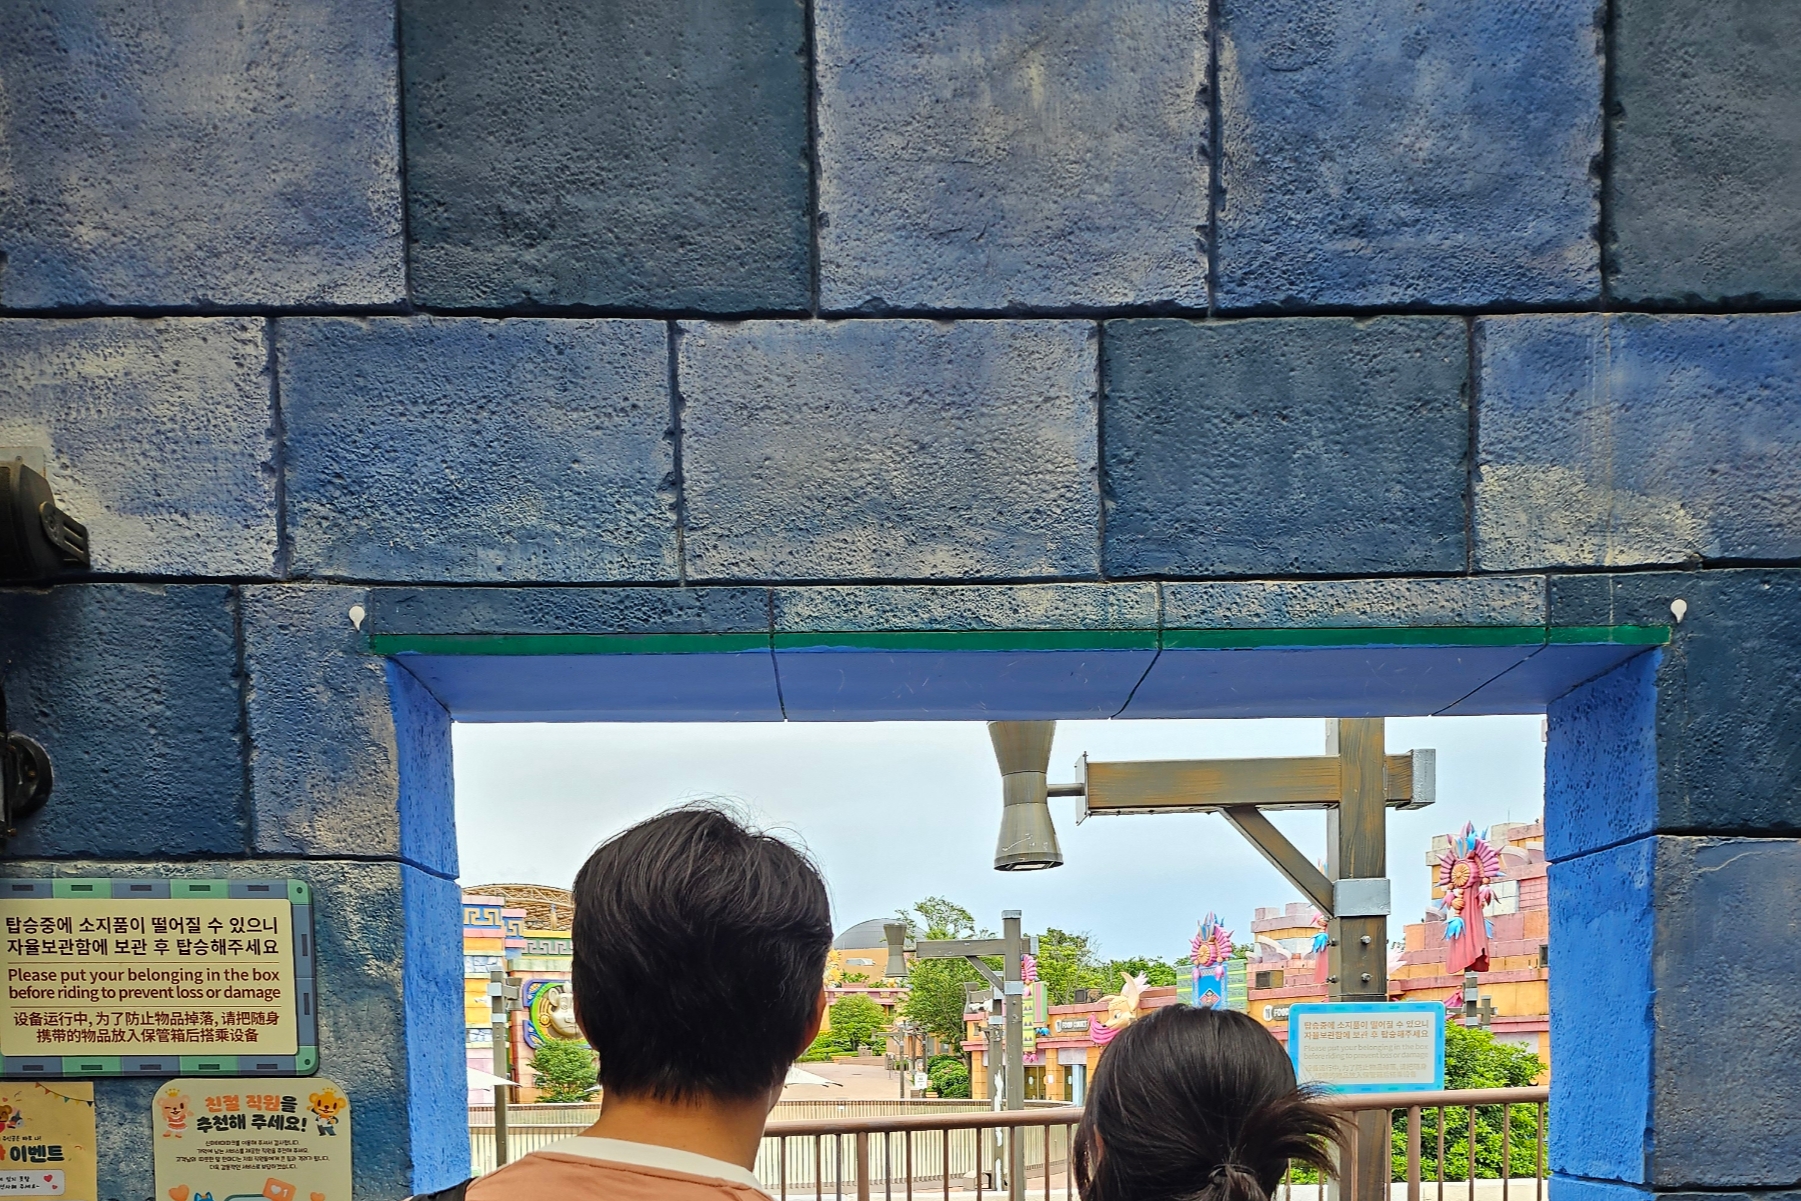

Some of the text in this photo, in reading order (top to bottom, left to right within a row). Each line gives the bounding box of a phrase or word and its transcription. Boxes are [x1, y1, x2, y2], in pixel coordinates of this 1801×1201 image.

[5, 916, 278, 935] 탑승중에 소지품이 떨어질 수 있으니
[6, 938, 279, 956] 자율보관함에 보관 후 탑승해주세요
[8, 967, 280, 986] Please put your belonging in the box
[9, 985, 281, 1002] before riding to prevent loss or damage
[1337, 1021, 1368, 1030] 소지품이
[1396, 1020, 1404, 1029] 수
[1406, 1019, 1429, 1029] 있으니
[36, 1028, 259, 1043] 携带的物品放入保管箱后搭乘设备
[1352, 1030, 1368, 1039] 보관
[1381, 1029, 1429, 1039] 탑승해주세요
[205, 1094, 299, 1114] 친절 직원을
[196, 1113, 308, 1134] 추천해 주세요!
[10, 1144, 65, 1163] 이벤트
